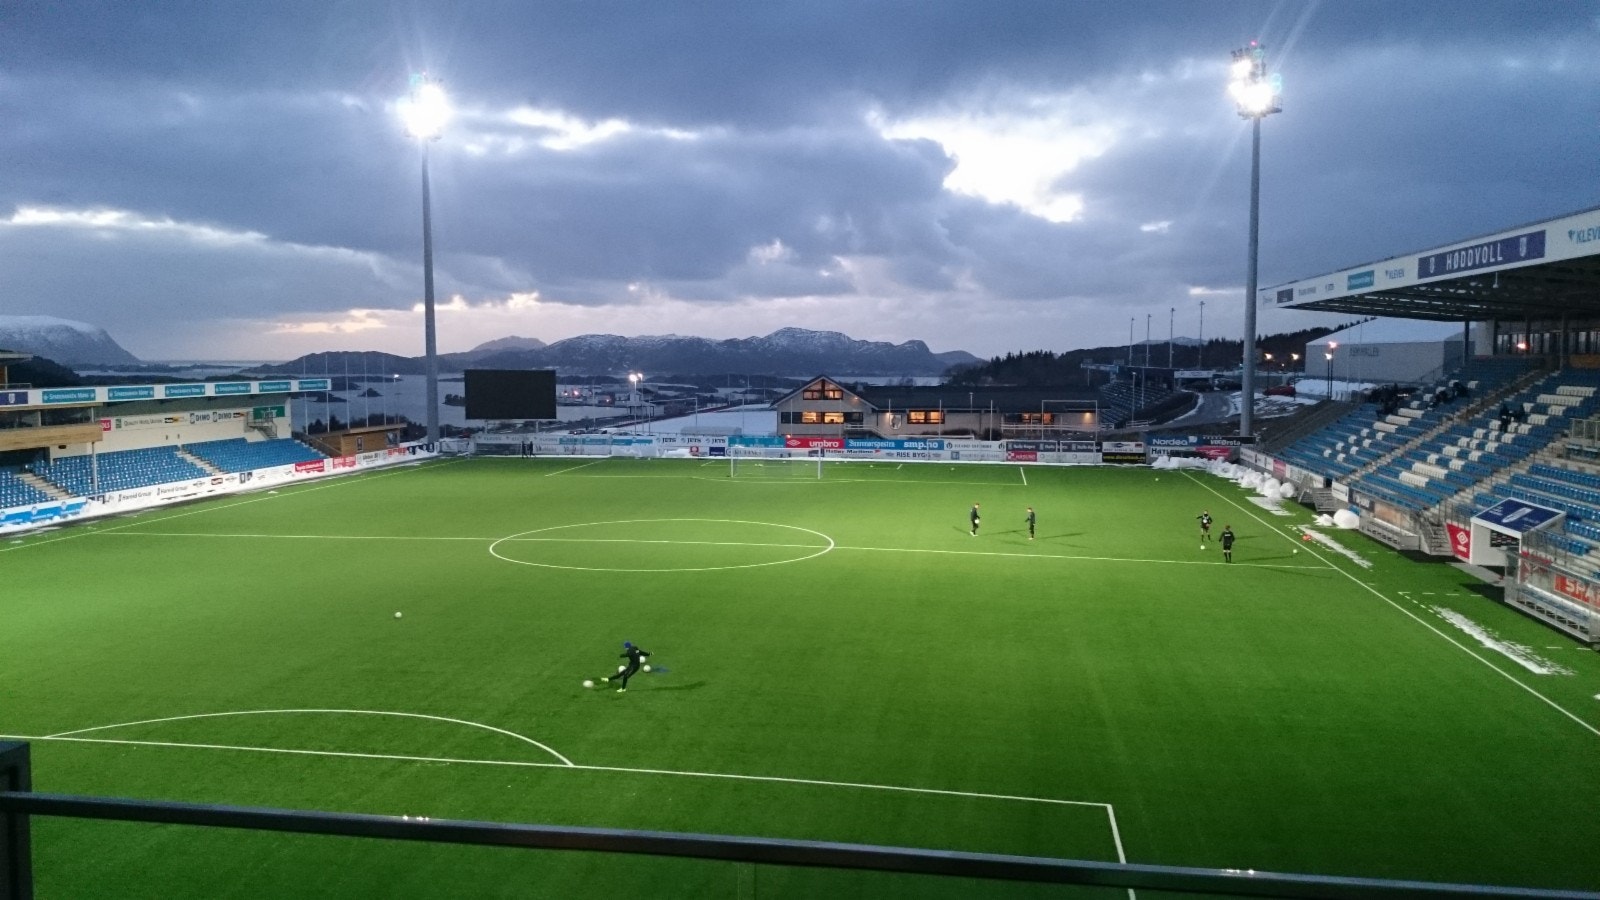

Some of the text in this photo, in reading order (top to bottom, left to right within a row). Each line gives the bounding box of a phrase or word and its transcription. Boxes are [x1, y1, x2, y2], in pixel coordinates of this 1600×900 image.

[1446, 242, 1503, 270] HØDDVOLL
[809, 439, 840, 448] umbro
[903, 440, 939, 450] smp.no
[1152, 438, 1188, 446] Nordea
